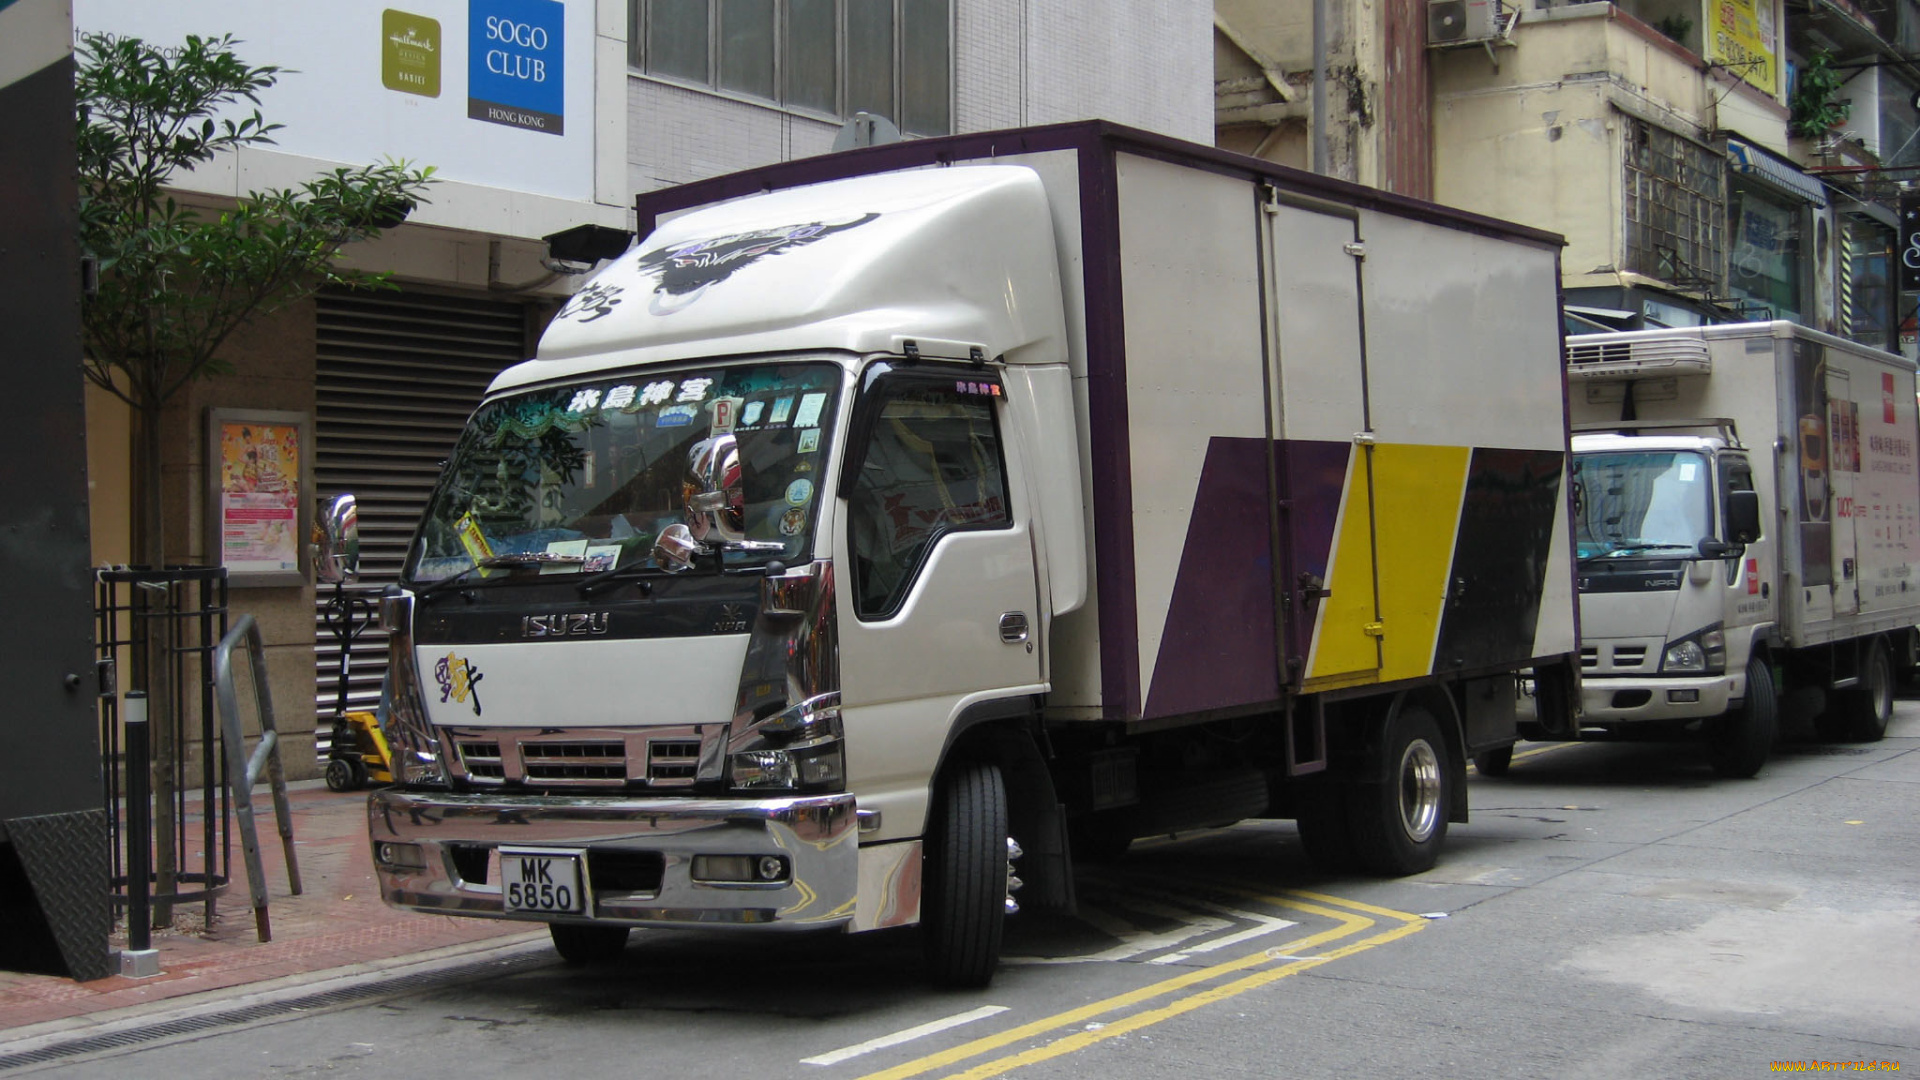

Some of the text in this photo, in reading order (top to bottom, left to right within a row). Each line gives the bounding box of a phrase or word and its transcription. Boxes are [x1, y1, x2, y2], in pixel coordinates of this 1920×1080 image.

[389, 30, 435, 52] Hallmark
[486, 15, 548, 51] SOGO
[486, 49, 546, 82] CLUB
[488, 107, 545, 128] HONG KONG
[1644, 578, 1679, 588] NPR
[521, 612, 610, 637] ISUZU
[521, 856, 553, 885] MK
[508, 882, 571, 911] 5850
